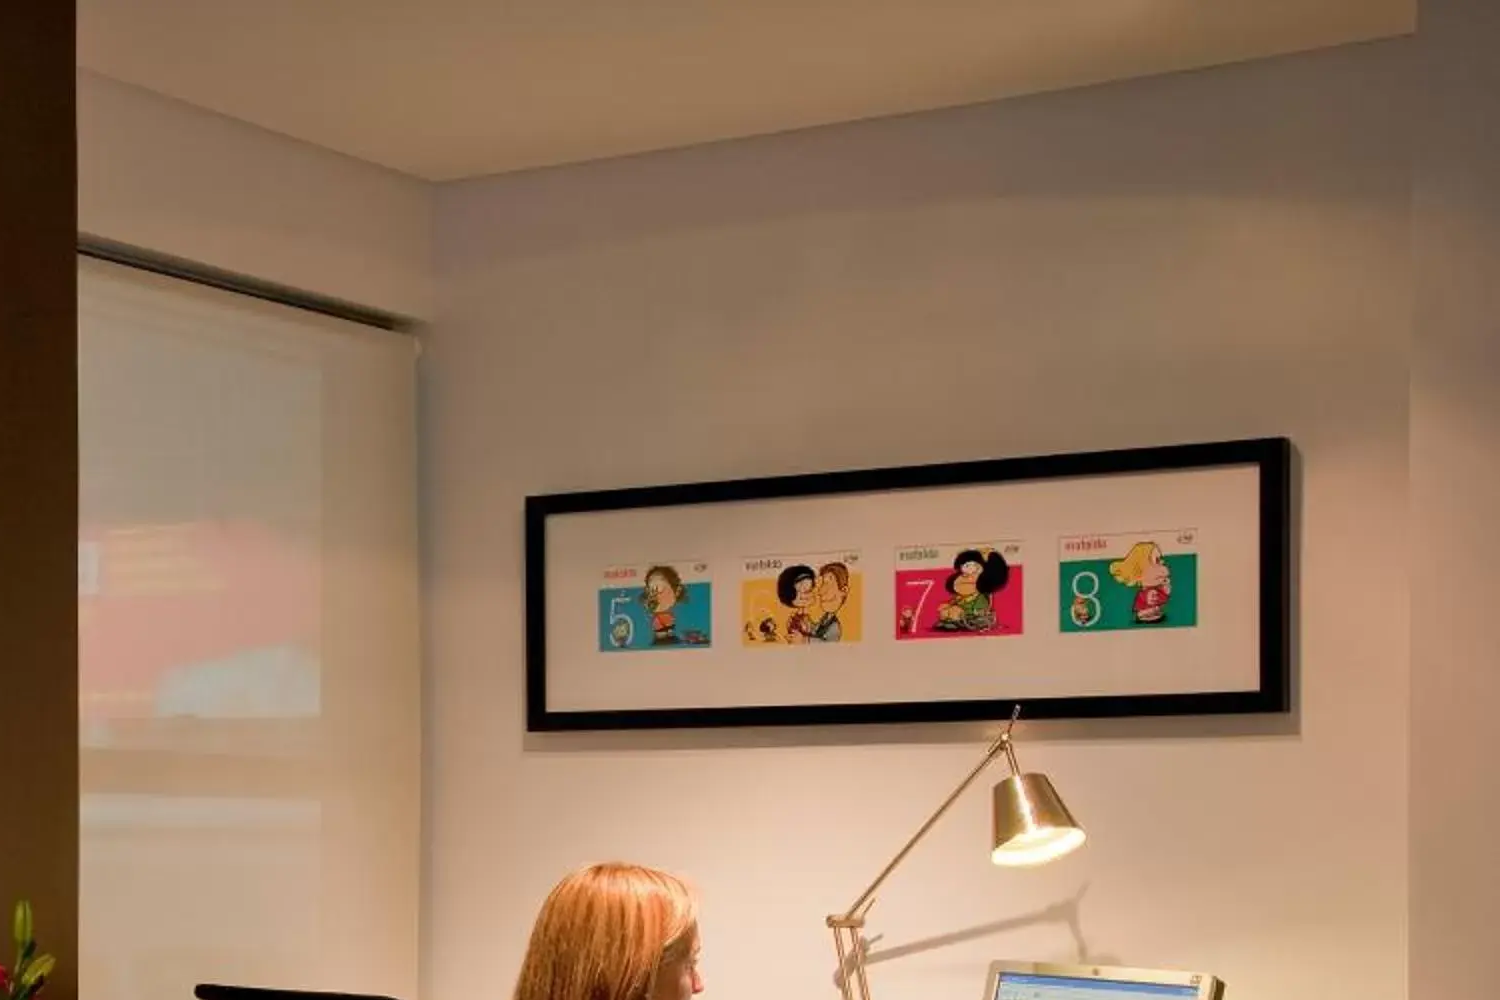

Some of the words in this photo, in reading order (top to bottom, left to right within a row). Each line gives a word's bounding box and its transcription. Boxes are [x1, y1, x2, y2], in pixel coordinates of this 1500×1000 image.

[608, 596, 635, 648] 5
[905, 579, 936, 633] 7
[1071, 571, 1101, 627] 8
